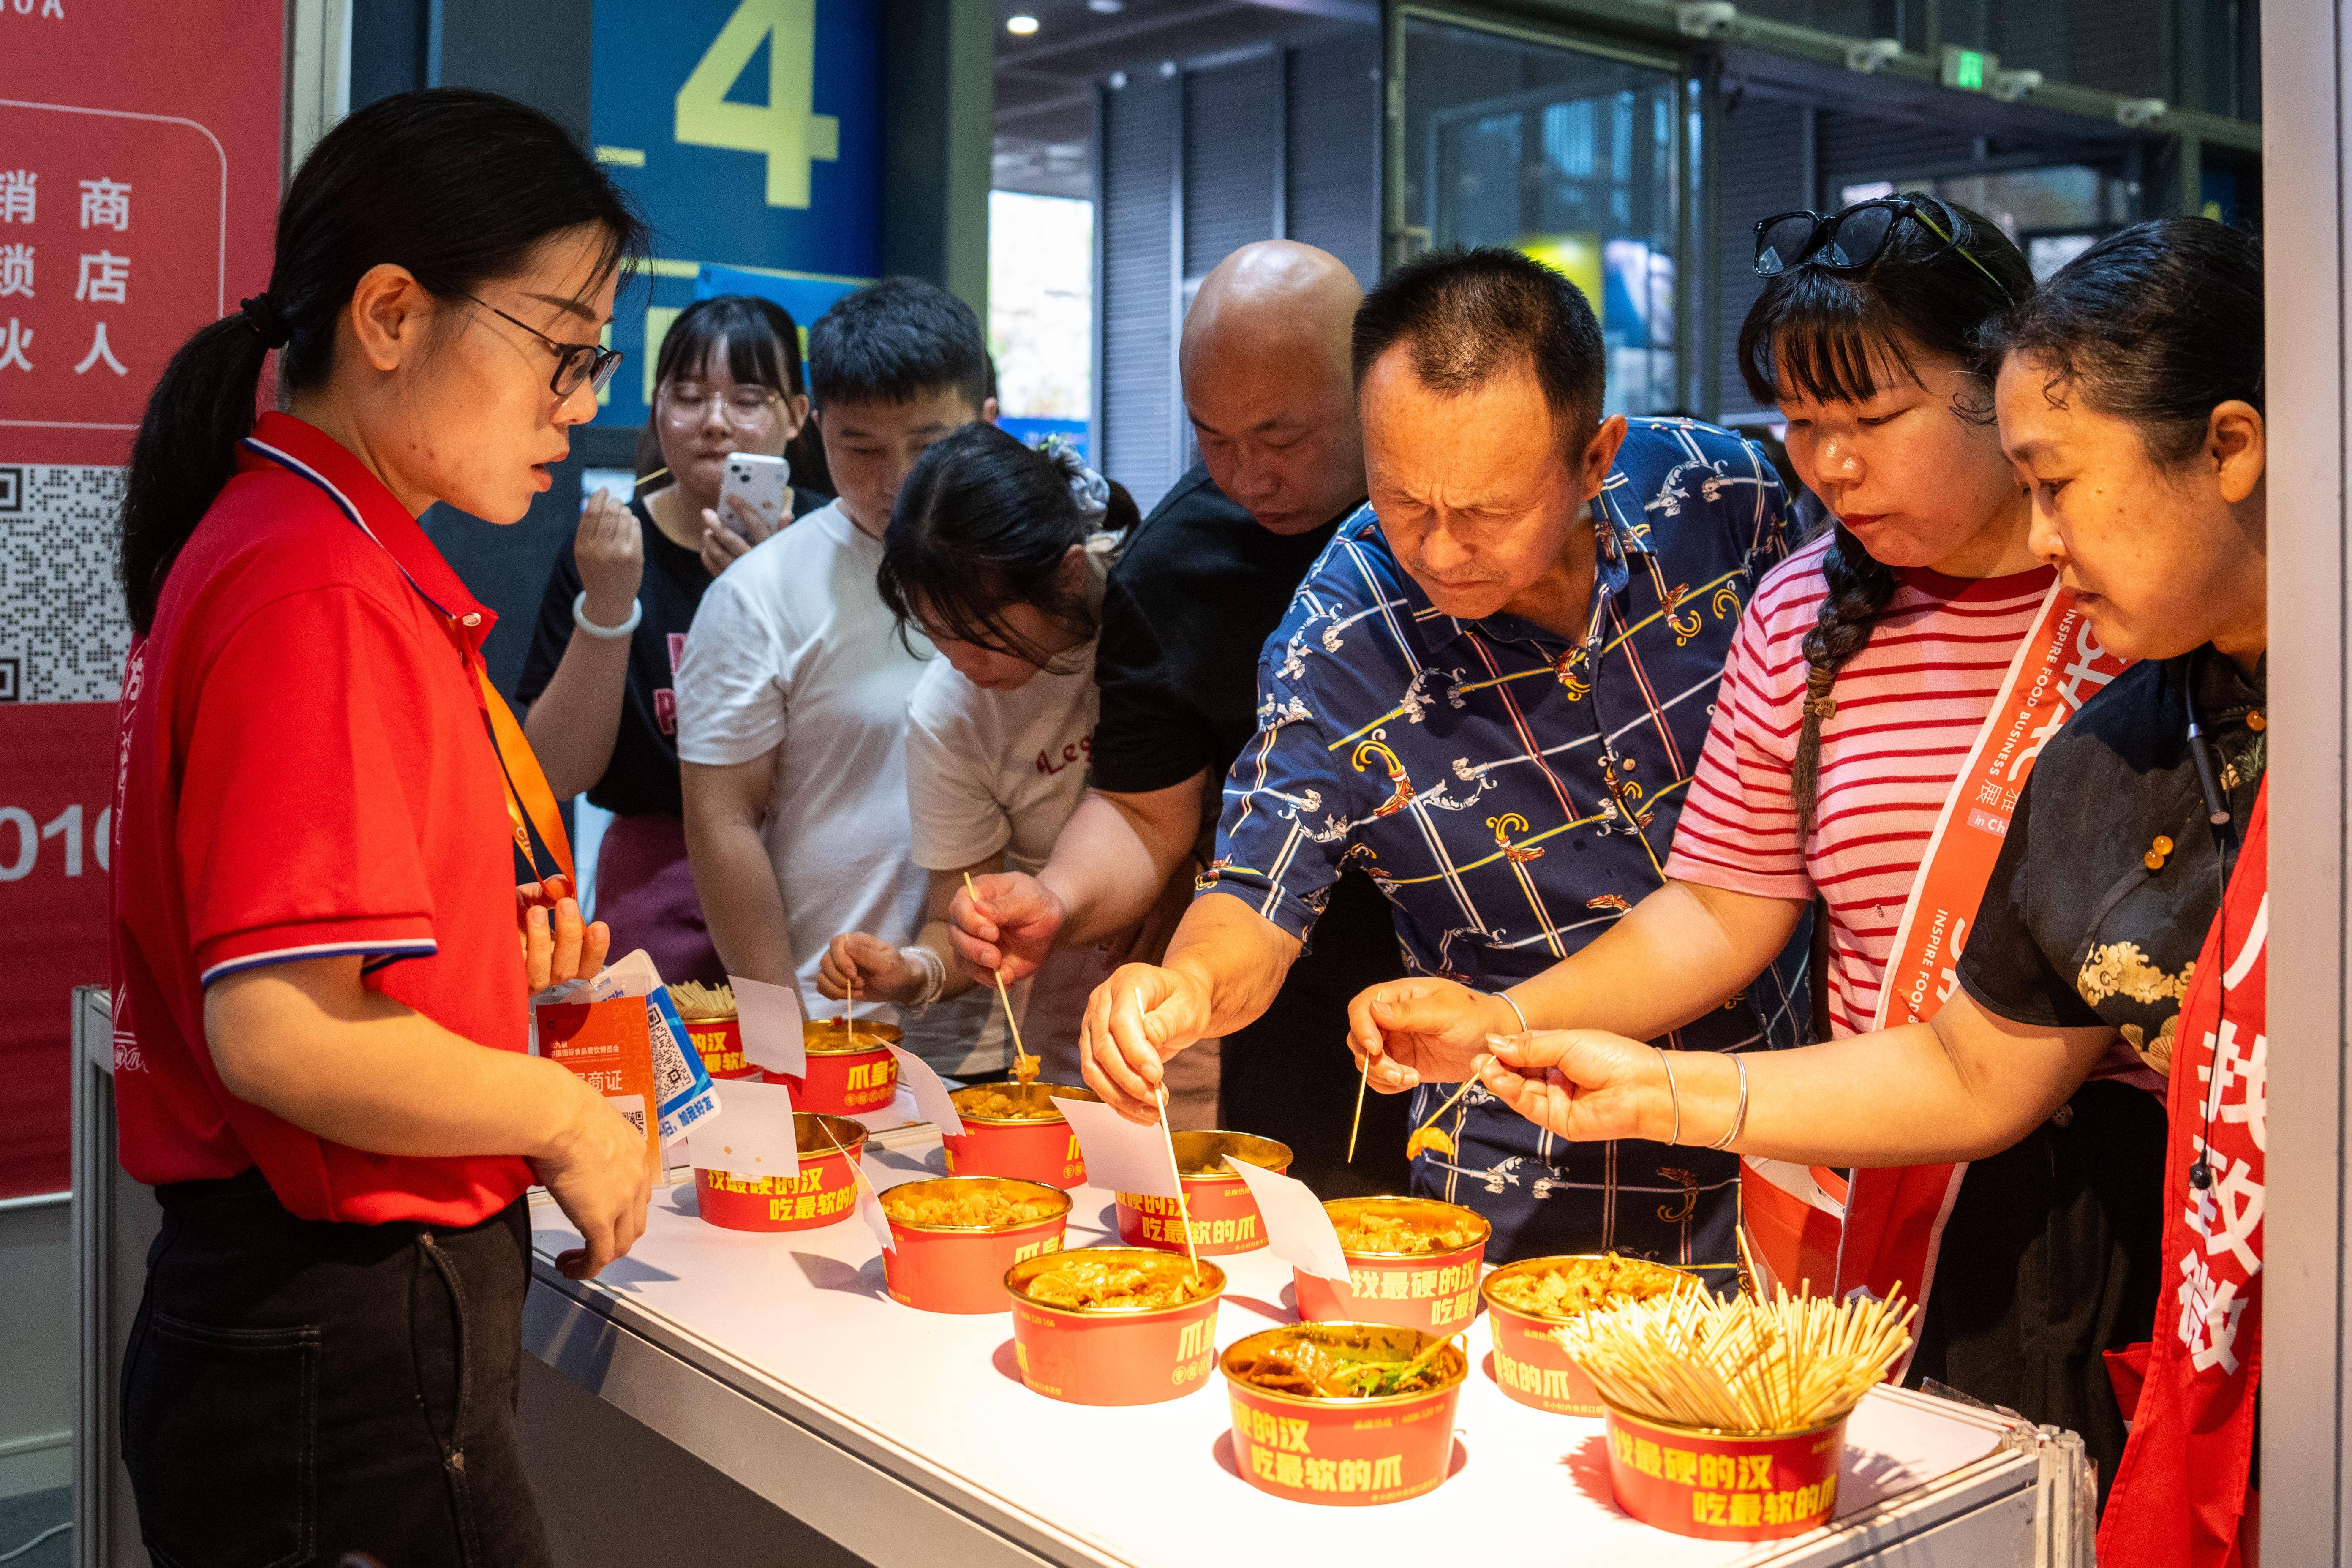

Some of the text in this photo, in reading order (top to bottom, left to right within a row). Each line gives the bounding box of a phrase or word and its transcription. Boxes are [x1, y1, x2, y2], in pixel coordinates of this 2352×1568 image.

[675, 0, 839, 209] 4
[2045, 609, 2078, 664] INSPIRE
[2027, 667, 2053, 708] FOOD
[1989, 711, 2030, 776] BUSINESS
[0, 804, 111, 881] 01
[1974, 815, 1985, 826] in
[1922, 908, 1949, 967] INSPIRE
[1908, 970, 1930, 1013] FOOD
[1142, 1214, 1256, 1245] 吃最软的爪
[1350, 1257, 1477, 1300] 找最硬的汉
[1251, 1443, 1403, 1492] 吃最软的爪
[1612, 1426, 1773, 1490] 找最硬的汉
[1692, 1474, 1837, 1527] 吃最软的爪
